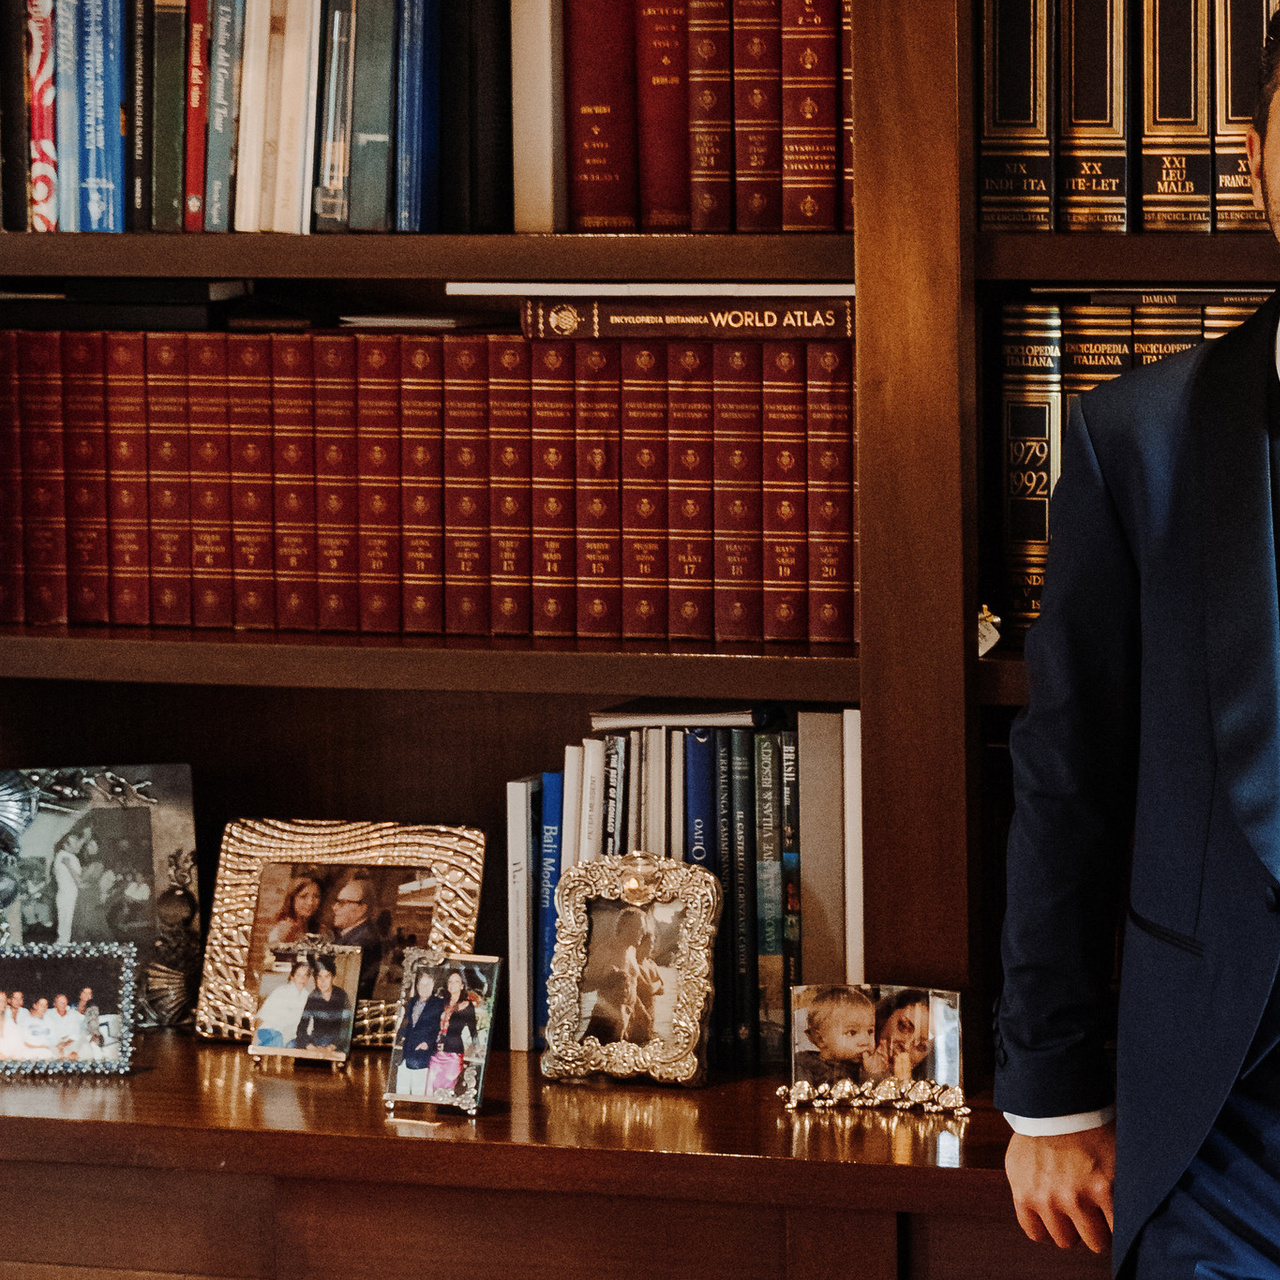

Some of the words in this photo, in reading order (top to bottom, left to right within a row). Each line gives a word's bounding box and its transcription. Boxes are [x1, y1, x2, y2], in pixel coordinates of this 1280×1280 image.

[1081, 163, 1102, 174] XX
[1162, 157, 1186, 168] XXI
[1162, 170, 1186, 181] LEU
[1157, 181, 1194, 193] MALB
[1142, 294, 1177, 305] DAMIANI
[665, 315, 709, 324] BRITANNICA
[709, 311, 777, 327] WORLD
[783, 311, 836, 327] ATLAS
[1065, 343, 1129, 355] ENCICLOPEDIA
[1073, 354, 1122, 366] ITALIANA
[1010, 441, 1048, 466] 1979
[1008, 472, 1048, 496] 1992
[761, 741, 772, 788] RESORTS
[783, 745, 795, 782] BRASIL
[609, 769, 617, 787] BEST
[719, 747, 728, 814] SERRALUNGA
[608, 788, 616, 798] OF
[762, 791, 772, 801] &
[607, 798, 616, 833] MONACO
[736, 811, 744, 820] IL
[762, 803, 773, 837] VILLAS
[543, 825, 558, 853] Bali
[736, 822, 744, 871] CASTELLO
[541, 858, 556, 908] Modern
